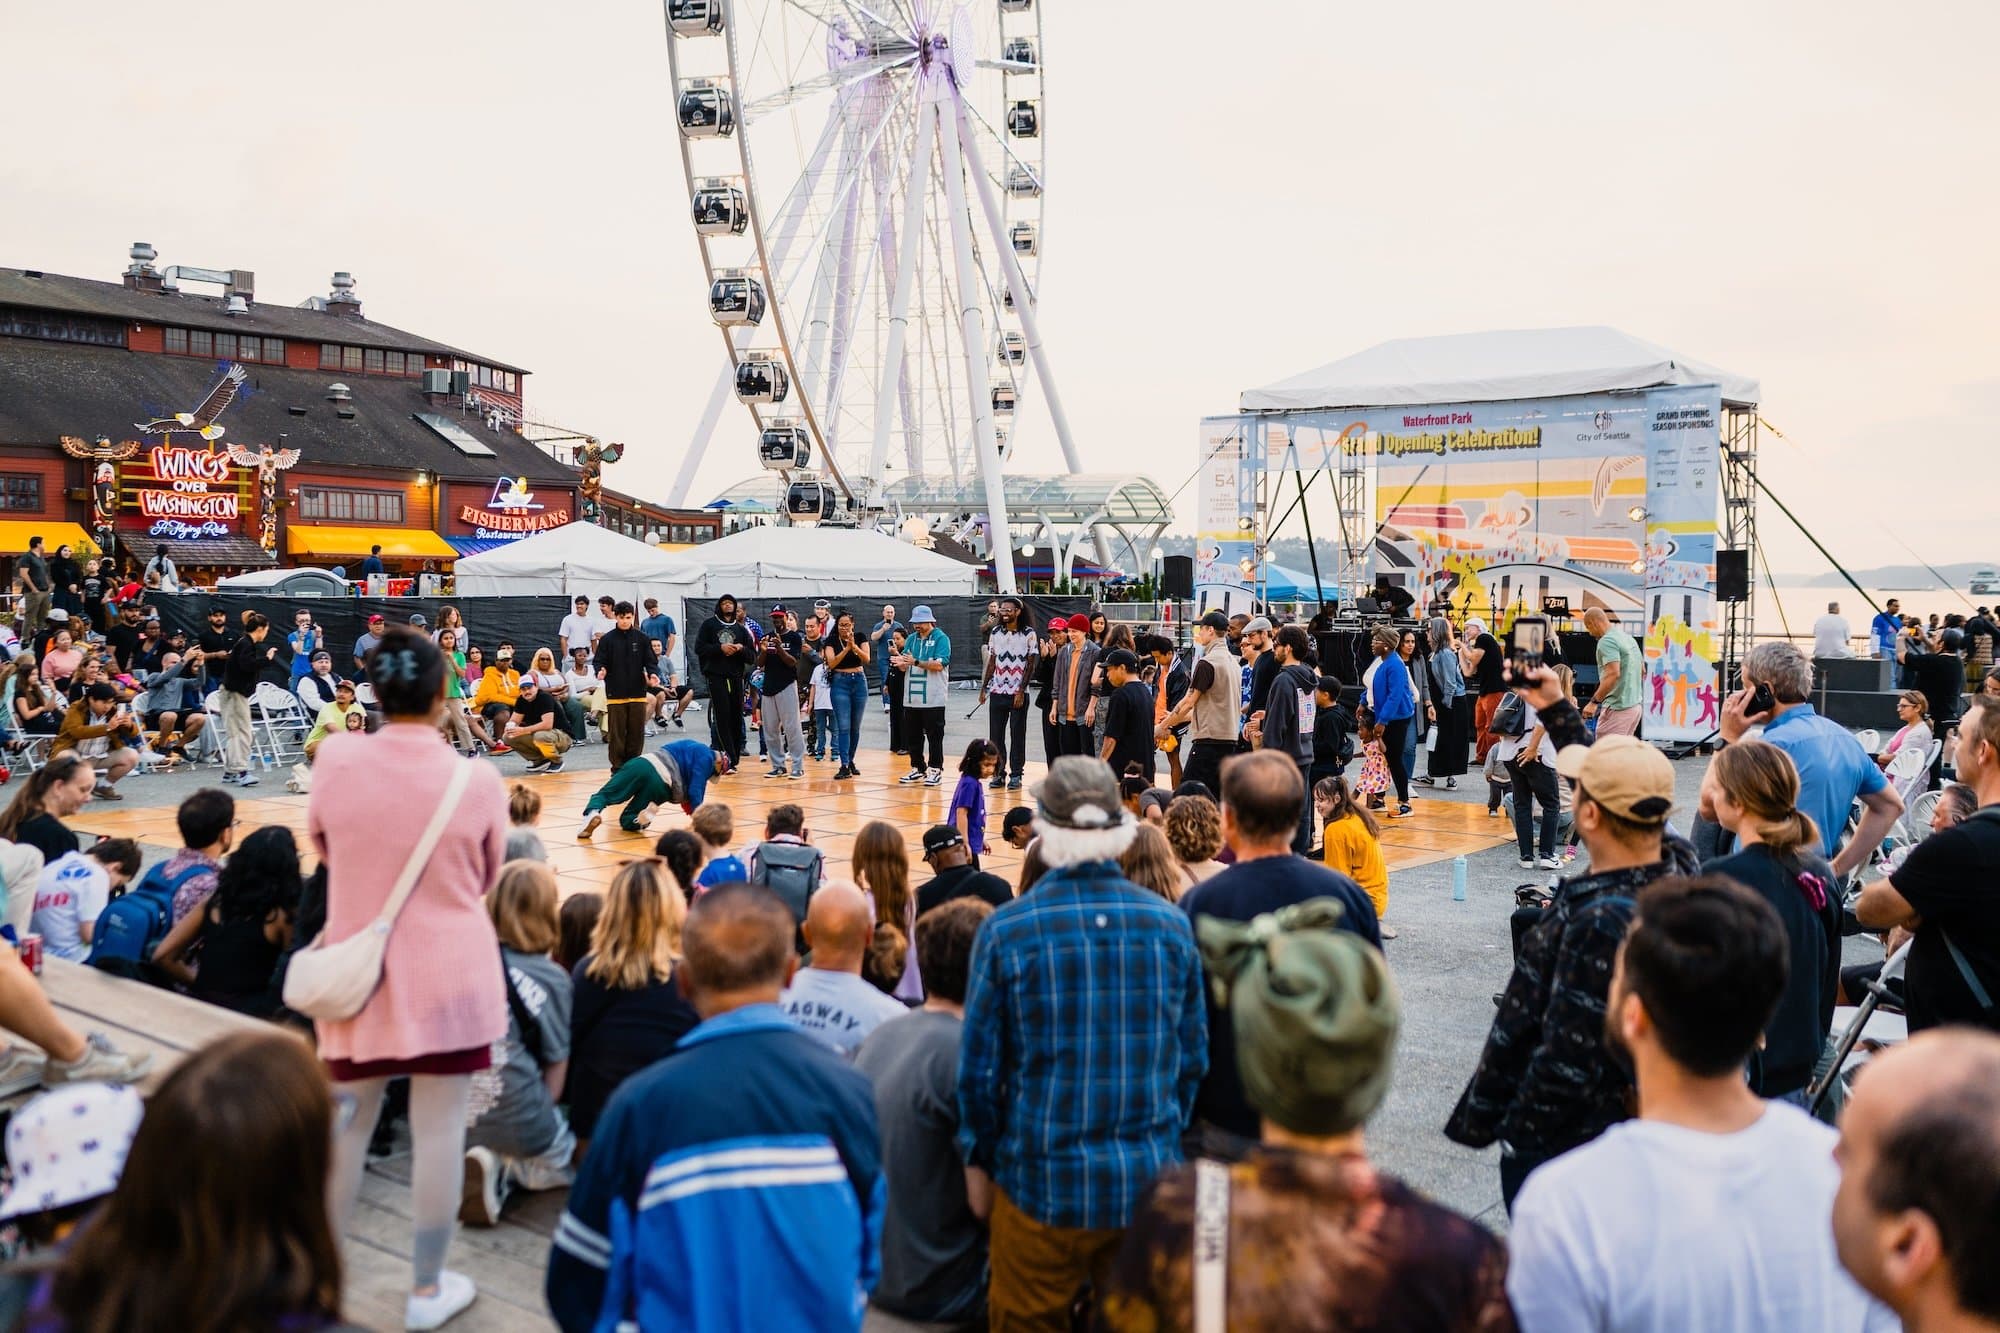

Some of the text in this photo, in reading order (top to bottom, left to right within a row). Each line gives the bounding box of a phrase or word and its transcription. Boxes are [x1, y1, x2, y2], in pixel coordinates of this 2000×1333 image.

[1403, 412, 1472, 427] Waterfront Park
[1656, 409, 1710, 420] GRAND OPENING
[1652, 419, 1714, 431] SEASON SPONSORS
[1386, 432, 1446, 458] Opening
[1448, 425, 1541, 452] Celebration!
[1577, 434, 1591, 442] City
[1603, 431, 1631, 440] Seattle
[154, 448, 230, 481] WINGS
[173, 481, 208, 493] OVER
[143, 491, 238, 518] WASHINGTON
[503, 507, 528, 515] THE
[460, 505, 569, 532] FISHERMANS
[150, 520, 168, 535] A
[167, 520, 202, 539] Flying
[476, 527, 526, 540] Restaurant
[782, 1000, 860, 1031] AGWAY
